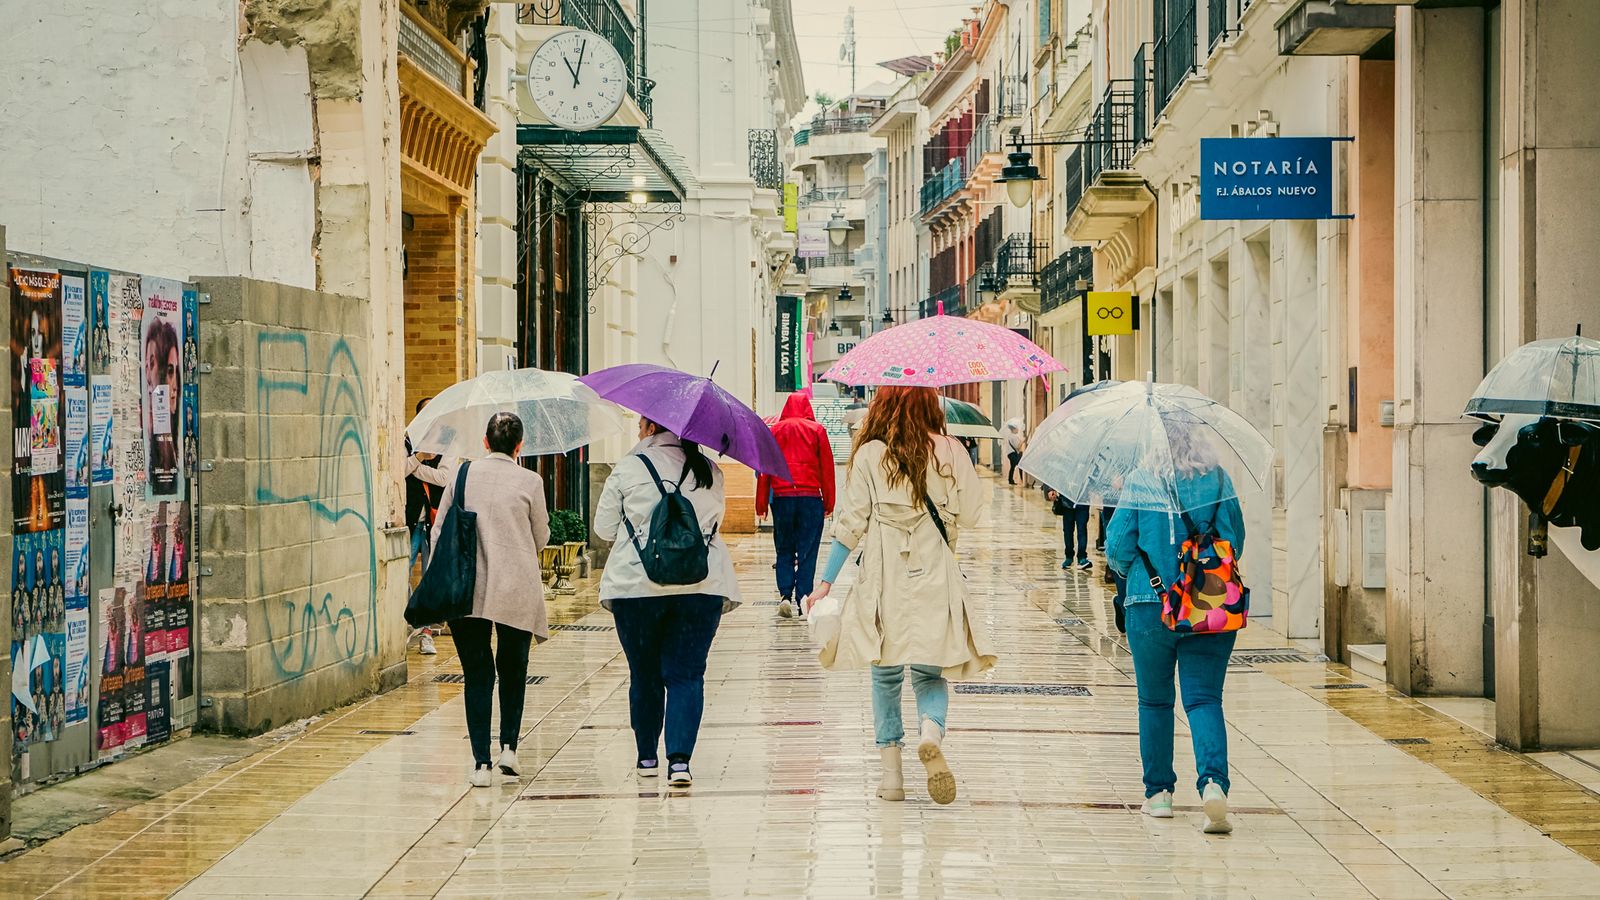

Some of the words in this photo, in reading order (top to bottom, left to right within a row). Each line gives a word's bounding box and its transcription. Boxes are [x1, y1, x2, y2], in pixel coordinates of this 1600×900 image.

[1214, 157, 1318, 176] NOTARÍA
[1232, 185, 1272, 196] ÁBALOS
[1277, 186, 1316, 195] NUEVO
[781, 312, 790, 343] BIMBA
[838, 342, 857, 354] BB
[781, 352, 789, 376] LOLA
[970, 368, 989, 376] VIBES
